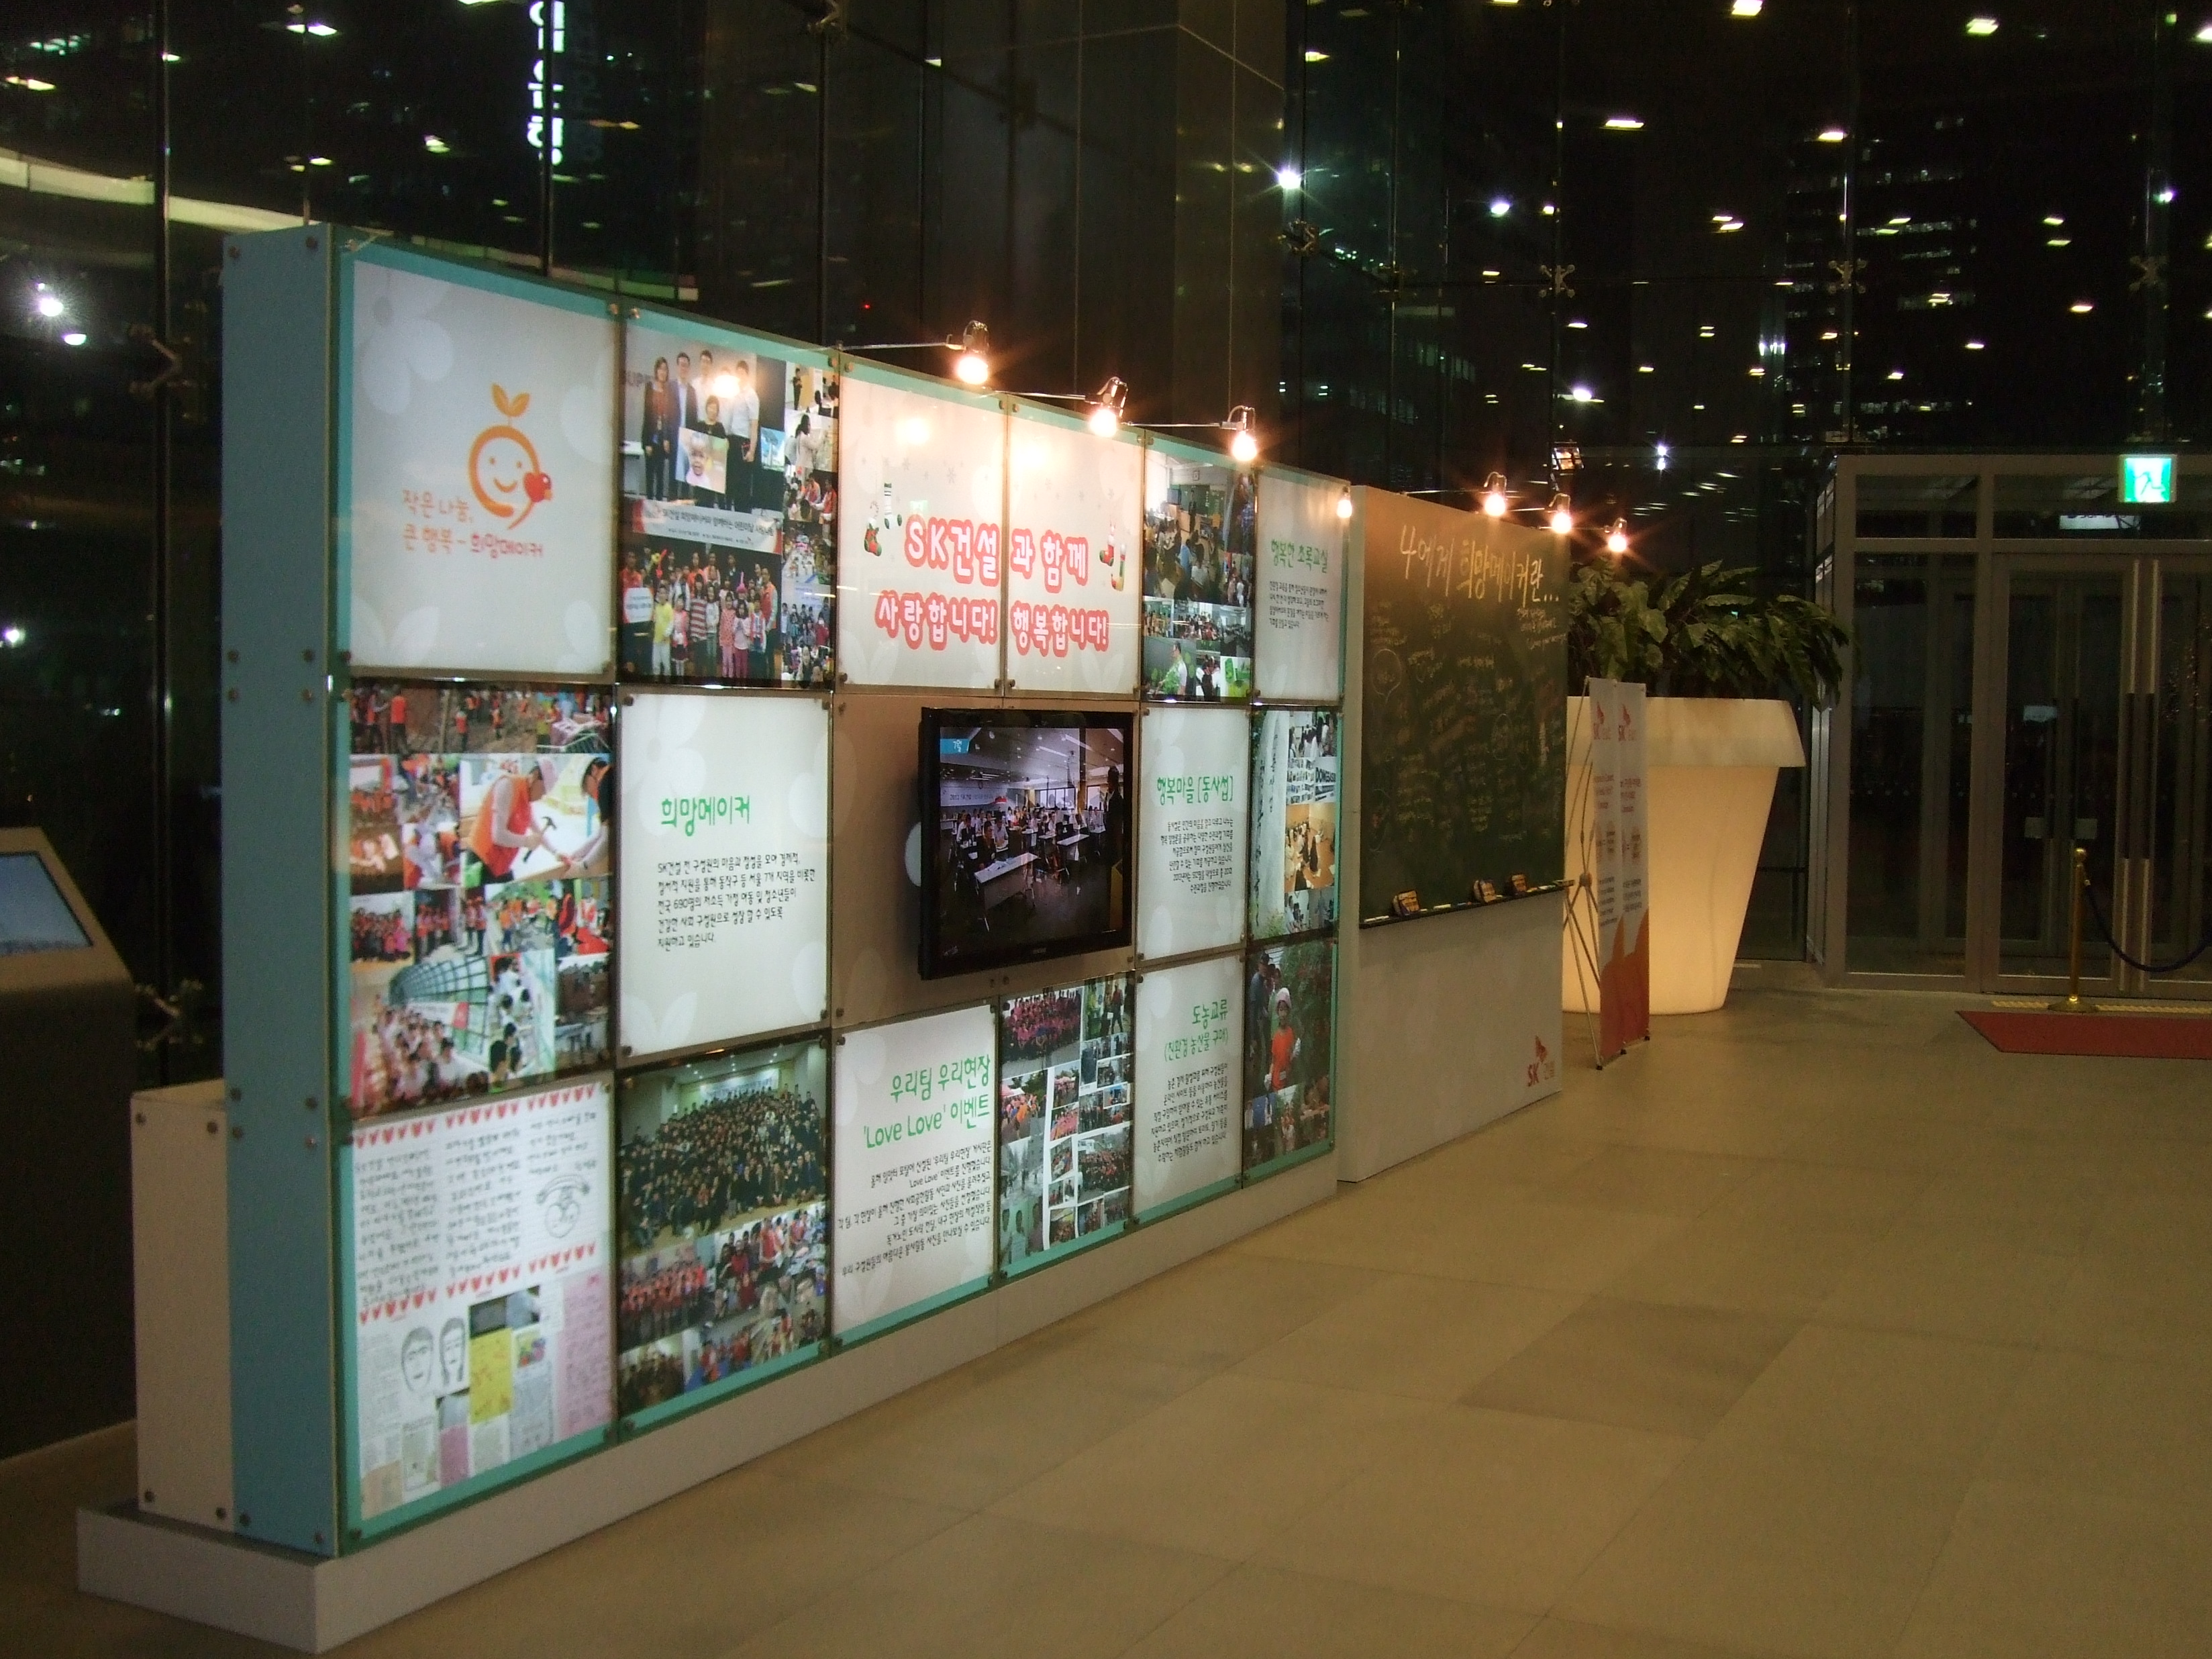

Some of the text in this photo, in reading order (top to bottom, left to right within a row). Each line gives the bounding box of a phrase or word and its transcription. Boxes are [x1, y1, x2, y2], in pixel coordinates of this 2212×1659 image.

[1040, 530, 1088, 593] 함께
[875, 590, 1109, 656] 사랑합니다! 행복합니다!
[1157, 776, 1195, 805] 행복마을
[661, 795, 750, 837] 희망메이커
[693, 859, 719, 873] 구성원의
[721, 856, 741, 871] 마음과
[743, 854, 762, 870] 정성을
[765, 854, 777, 862] 모아
[681, 878, 701, 893] 지원을
[719, 875, 738, 890] 동작구
[740, 874, 747, 888] 등
[749, 872, 762, 887] 서울
[776, 870, 795, 884] 지역을
[705, 895, 723, 907] 저소득
[725, 894, 738, 907] 가정
[741, 892, 754, 905] 아동
[764, 888, 797, 903] 청소년들이
[696, 913, 730, 928] 구성원으로
[764, 907, 783, 921] 있도록
[1192, 999, 1228, 1029] 도농교류
[890, 1054, 991, 1103] 우리팀 우리현장
[950, 1094, 990, 1129] 이벤트
